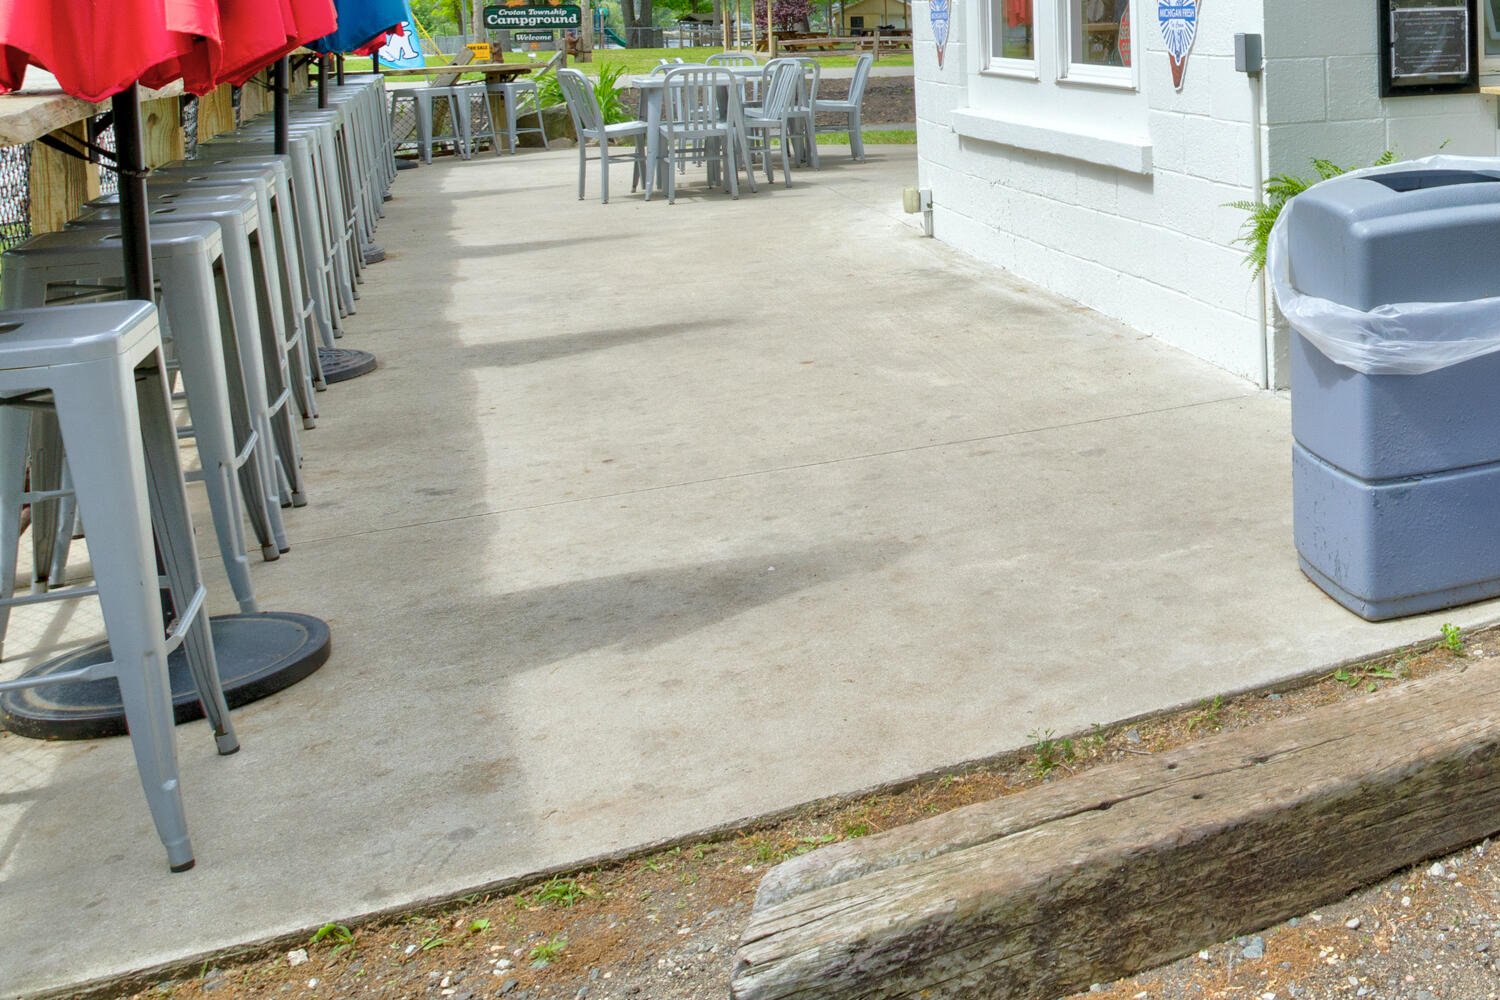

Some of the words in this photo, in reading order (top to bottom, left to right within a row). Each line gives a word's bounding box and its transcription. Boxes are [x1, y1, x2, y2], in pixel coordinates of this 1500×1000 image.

[498, 8, 526, 16] Croton
[528, 8, 568, 17] Township
[487, 14, 578, 26] Campground
[515, 33, 552, 41] Welcome
